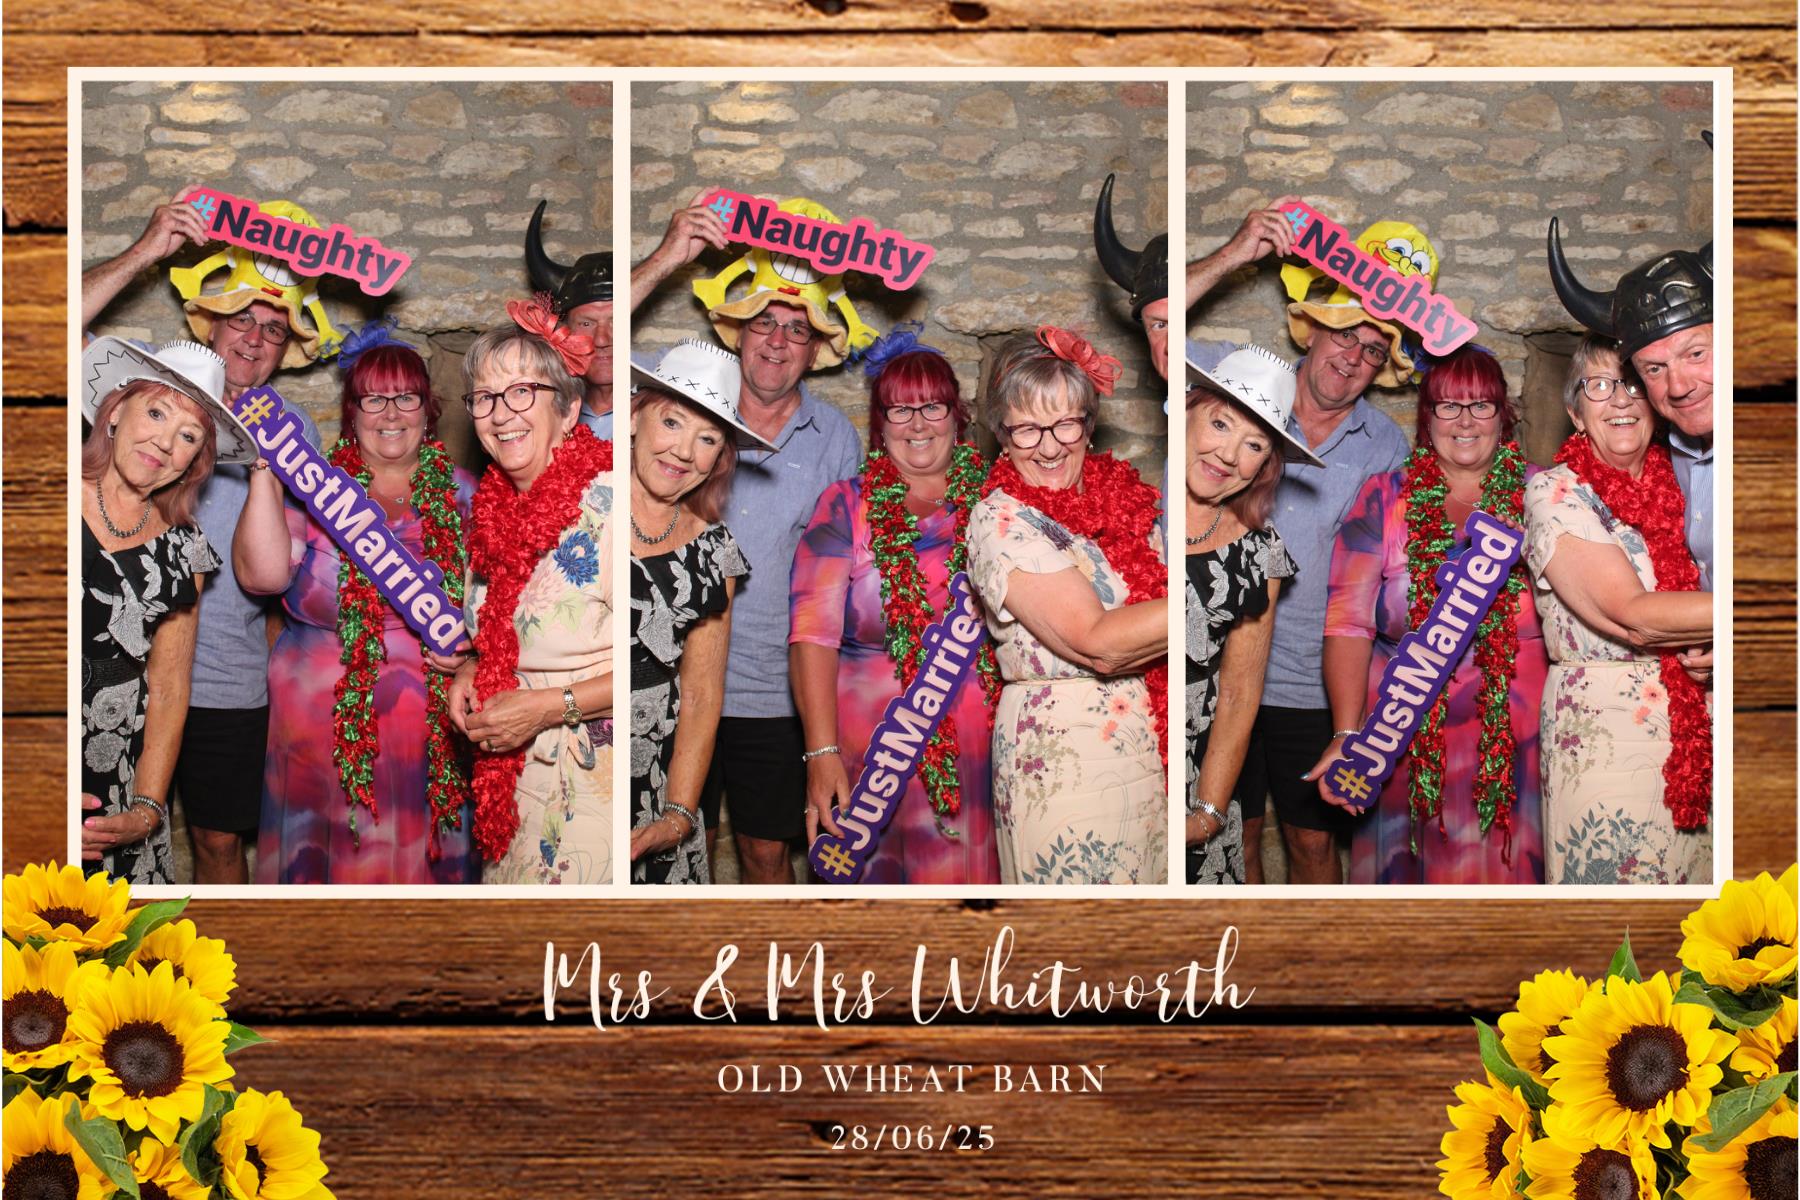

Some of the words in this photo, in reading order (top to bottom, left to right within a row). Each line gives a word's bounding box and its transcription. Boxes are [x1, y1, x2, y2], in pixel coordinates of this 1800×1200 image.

[190, 193, 403, 288] #Naughty
[708, 195, 926, 282] #Naughty
[1285, 207, 1470, 349] #Naughty
[238, 393, 466, 650] #JustMarried
[1333, 520, 1519, 801] #JustMarried
